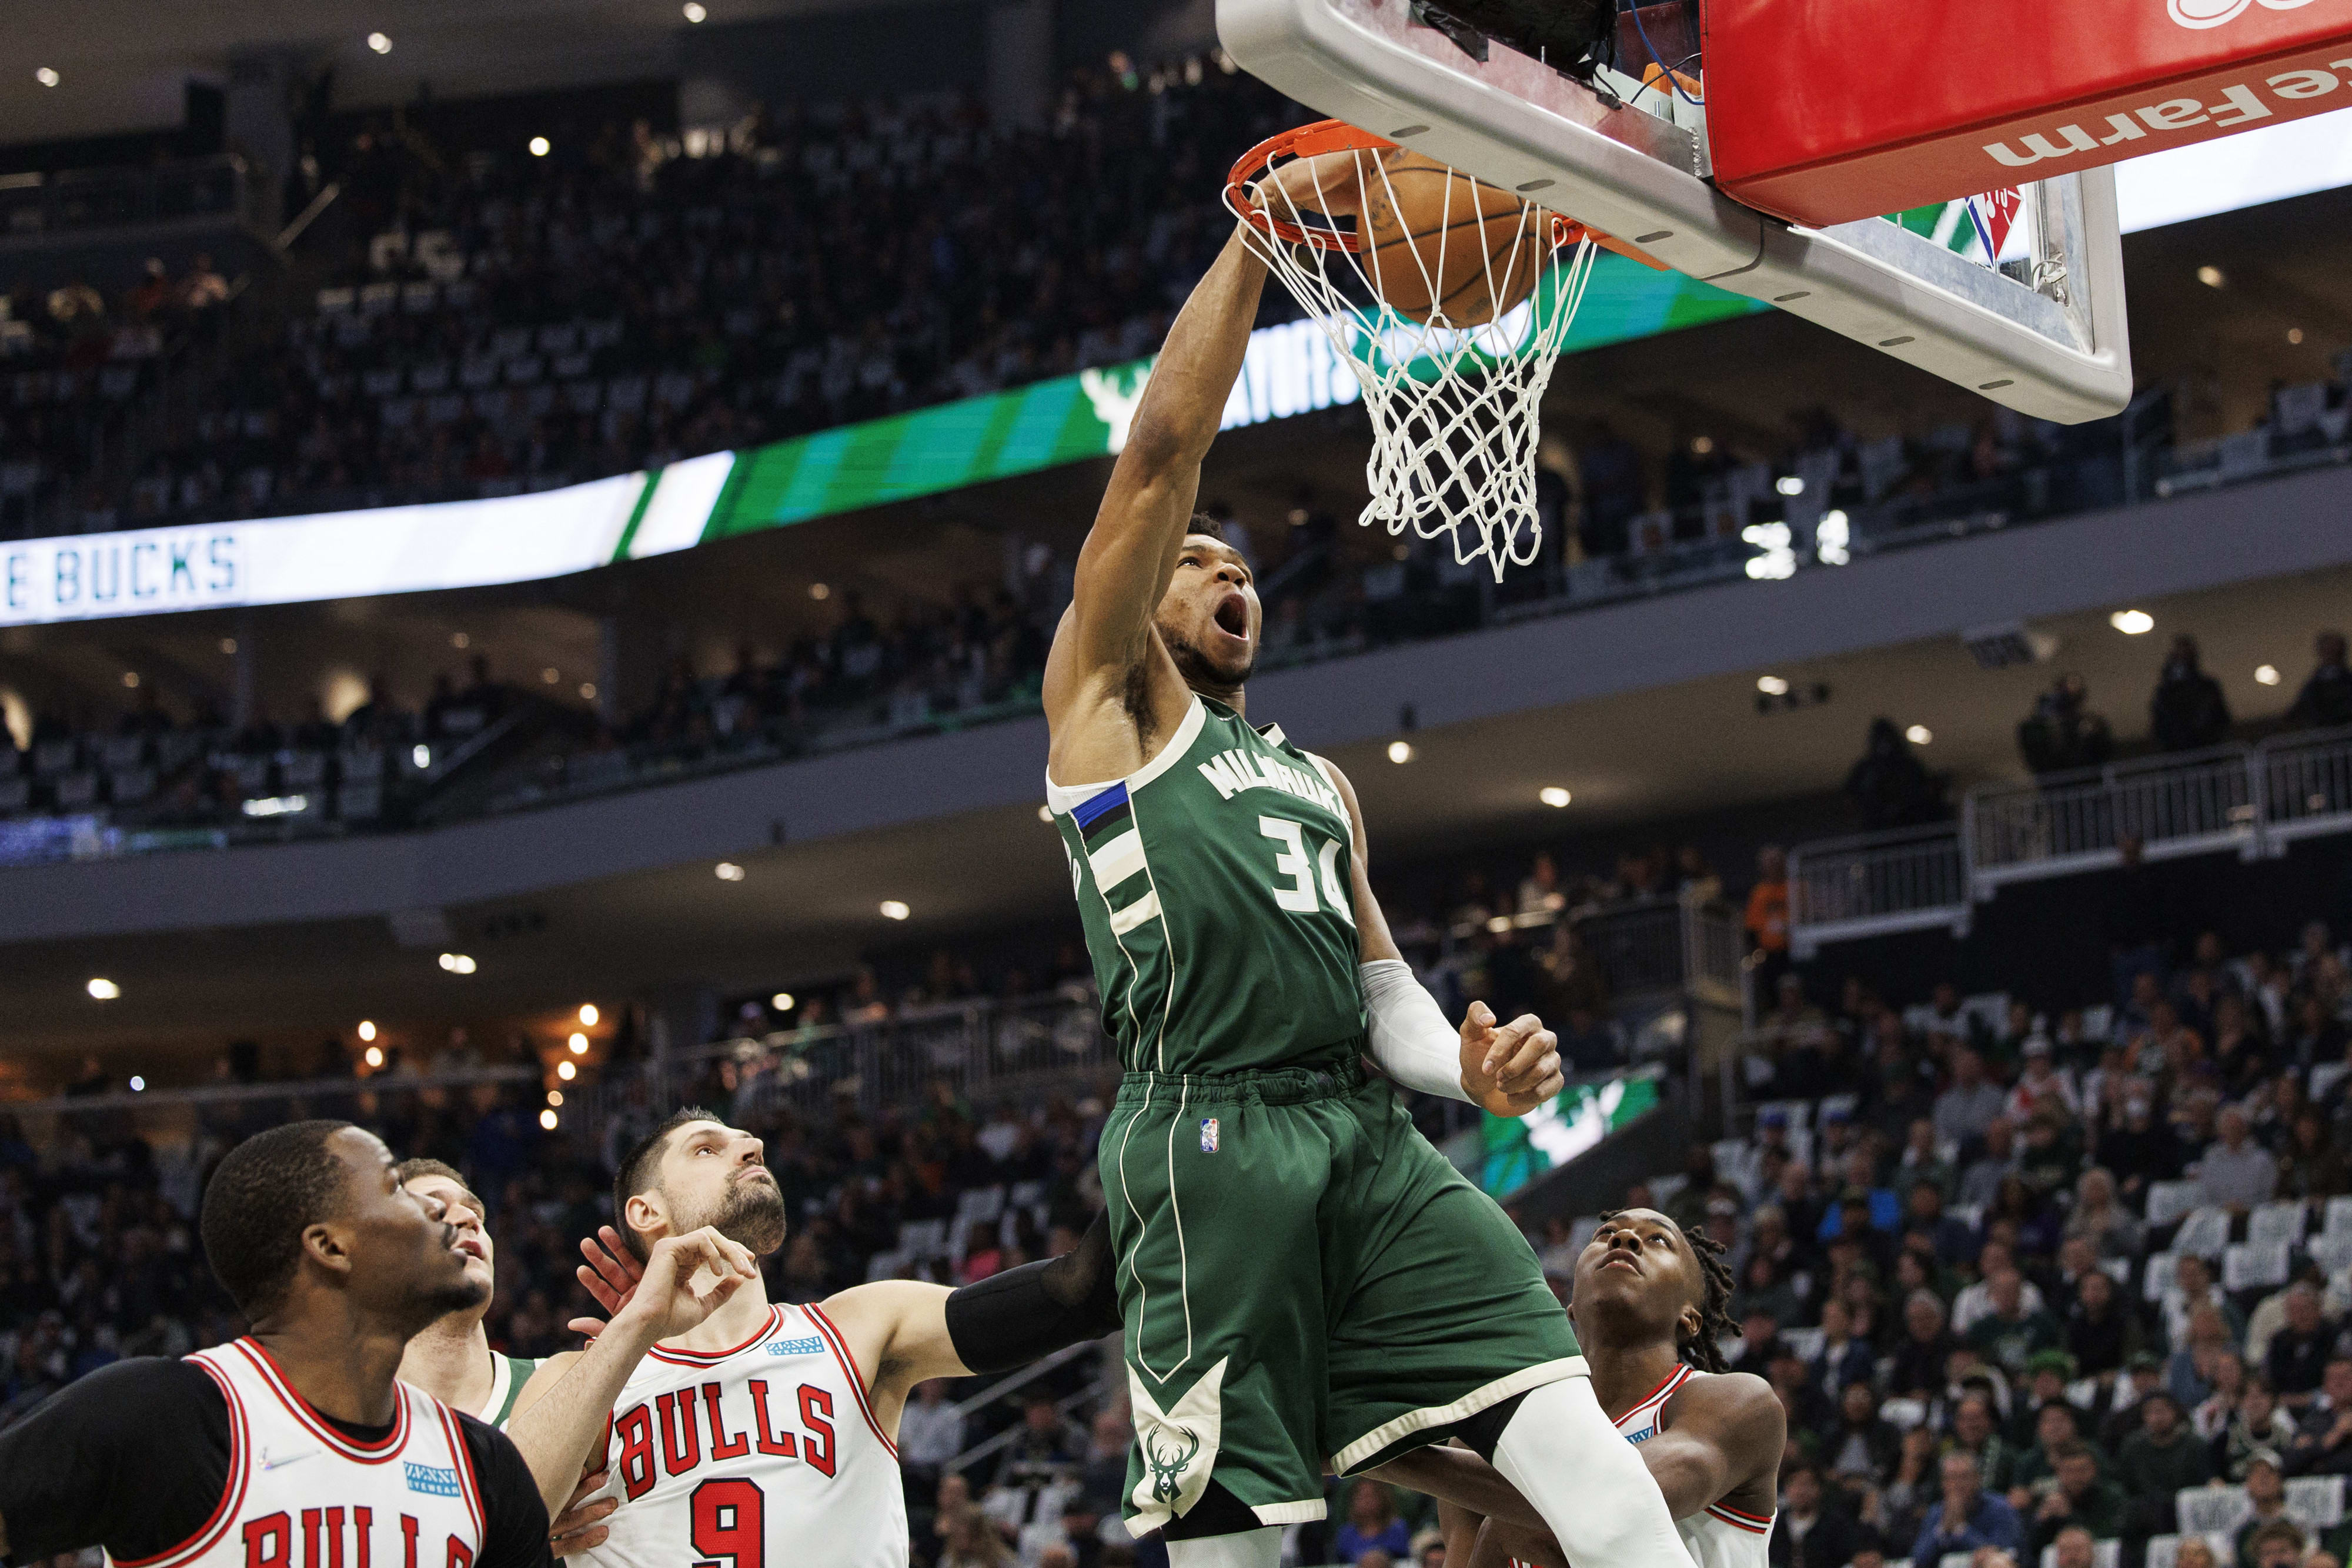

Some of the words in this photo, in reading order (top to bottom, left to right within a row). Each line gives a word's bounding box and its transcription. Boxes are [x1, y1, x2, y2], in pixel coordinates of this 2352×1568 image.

[1982, 84, 2273, 167] Farm
[54, 536, 235, 605] BUCKS
[766, 1337, 821, 1350] ZENNI
[769, 1346, 823, 1355] EYEWEAR
[614, 1379, 837, 1503] BULLS
[408, 1480, 459, 1495] EYEWEAR
[689, 1477, 766, 1568] 9
